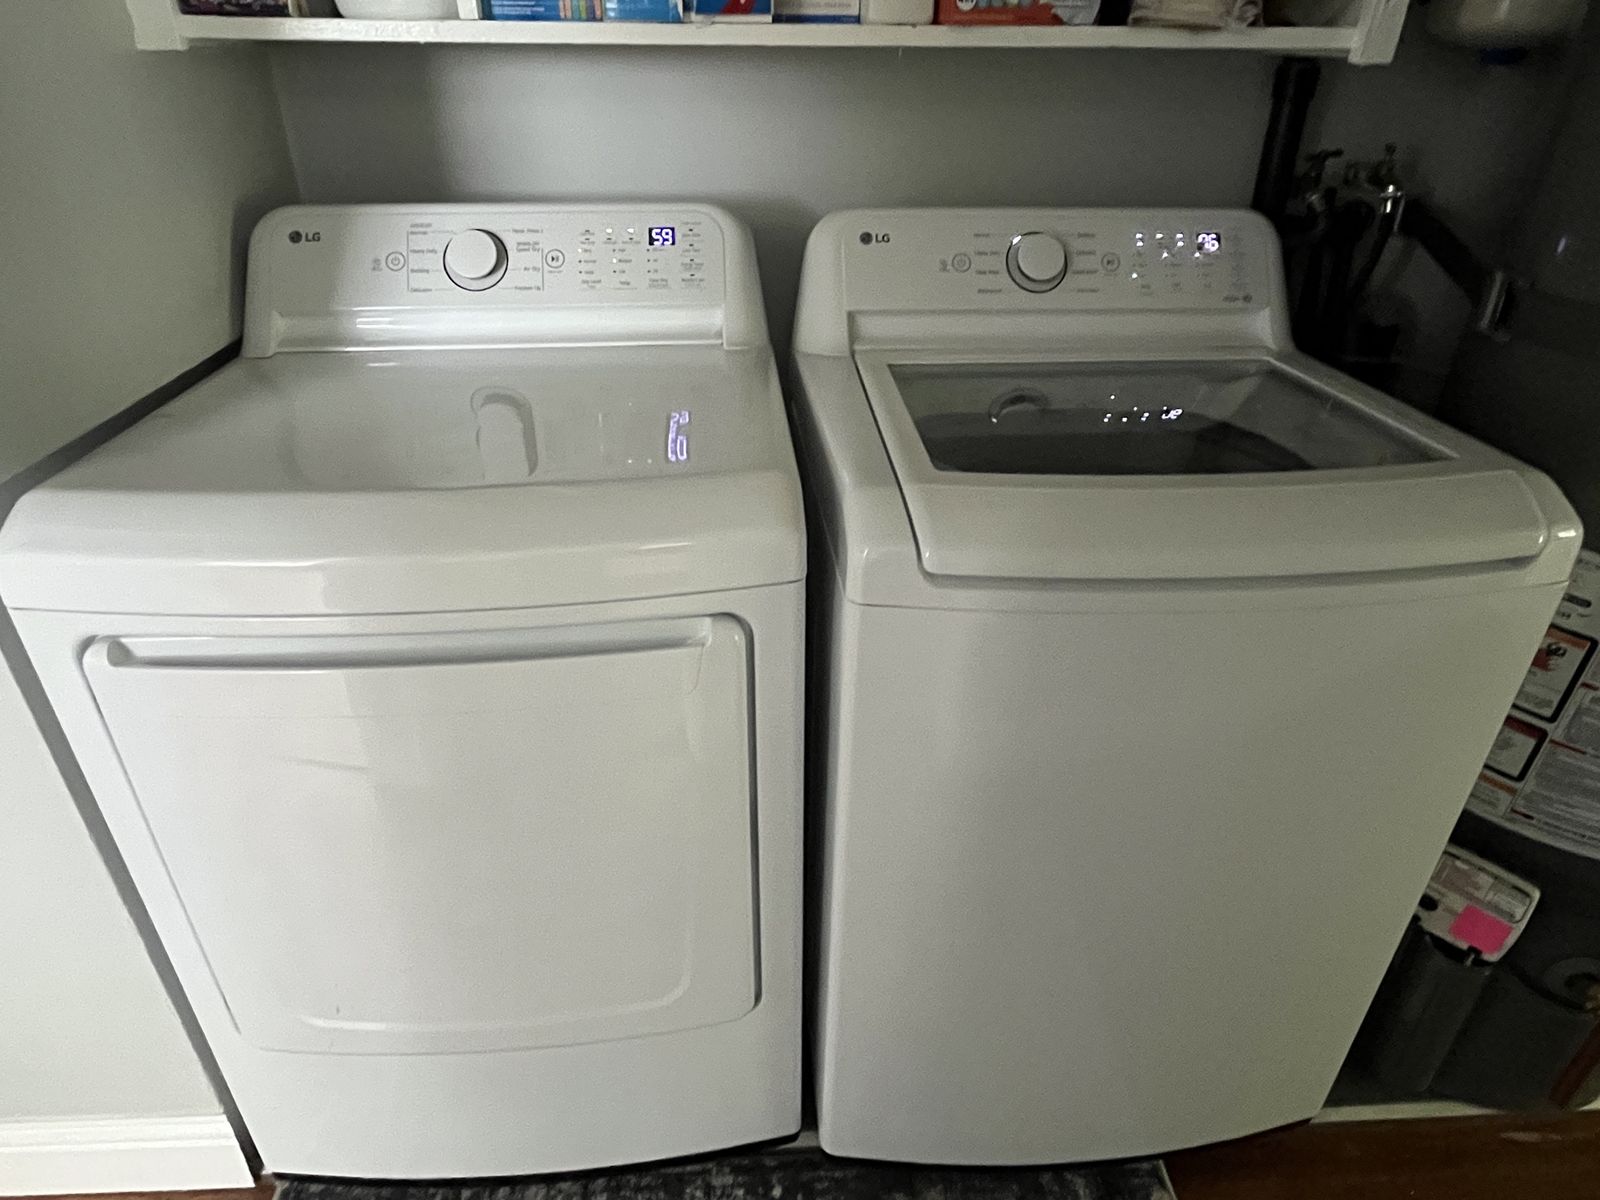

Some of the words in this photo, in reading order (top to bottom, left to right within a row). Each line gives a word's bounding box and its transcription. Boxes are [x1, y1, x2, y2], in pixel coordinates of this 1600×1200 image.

[305, 232, 320, 242] LG
[652, 228, 673, 245] 59
[875, 233, 890, 243] LG
